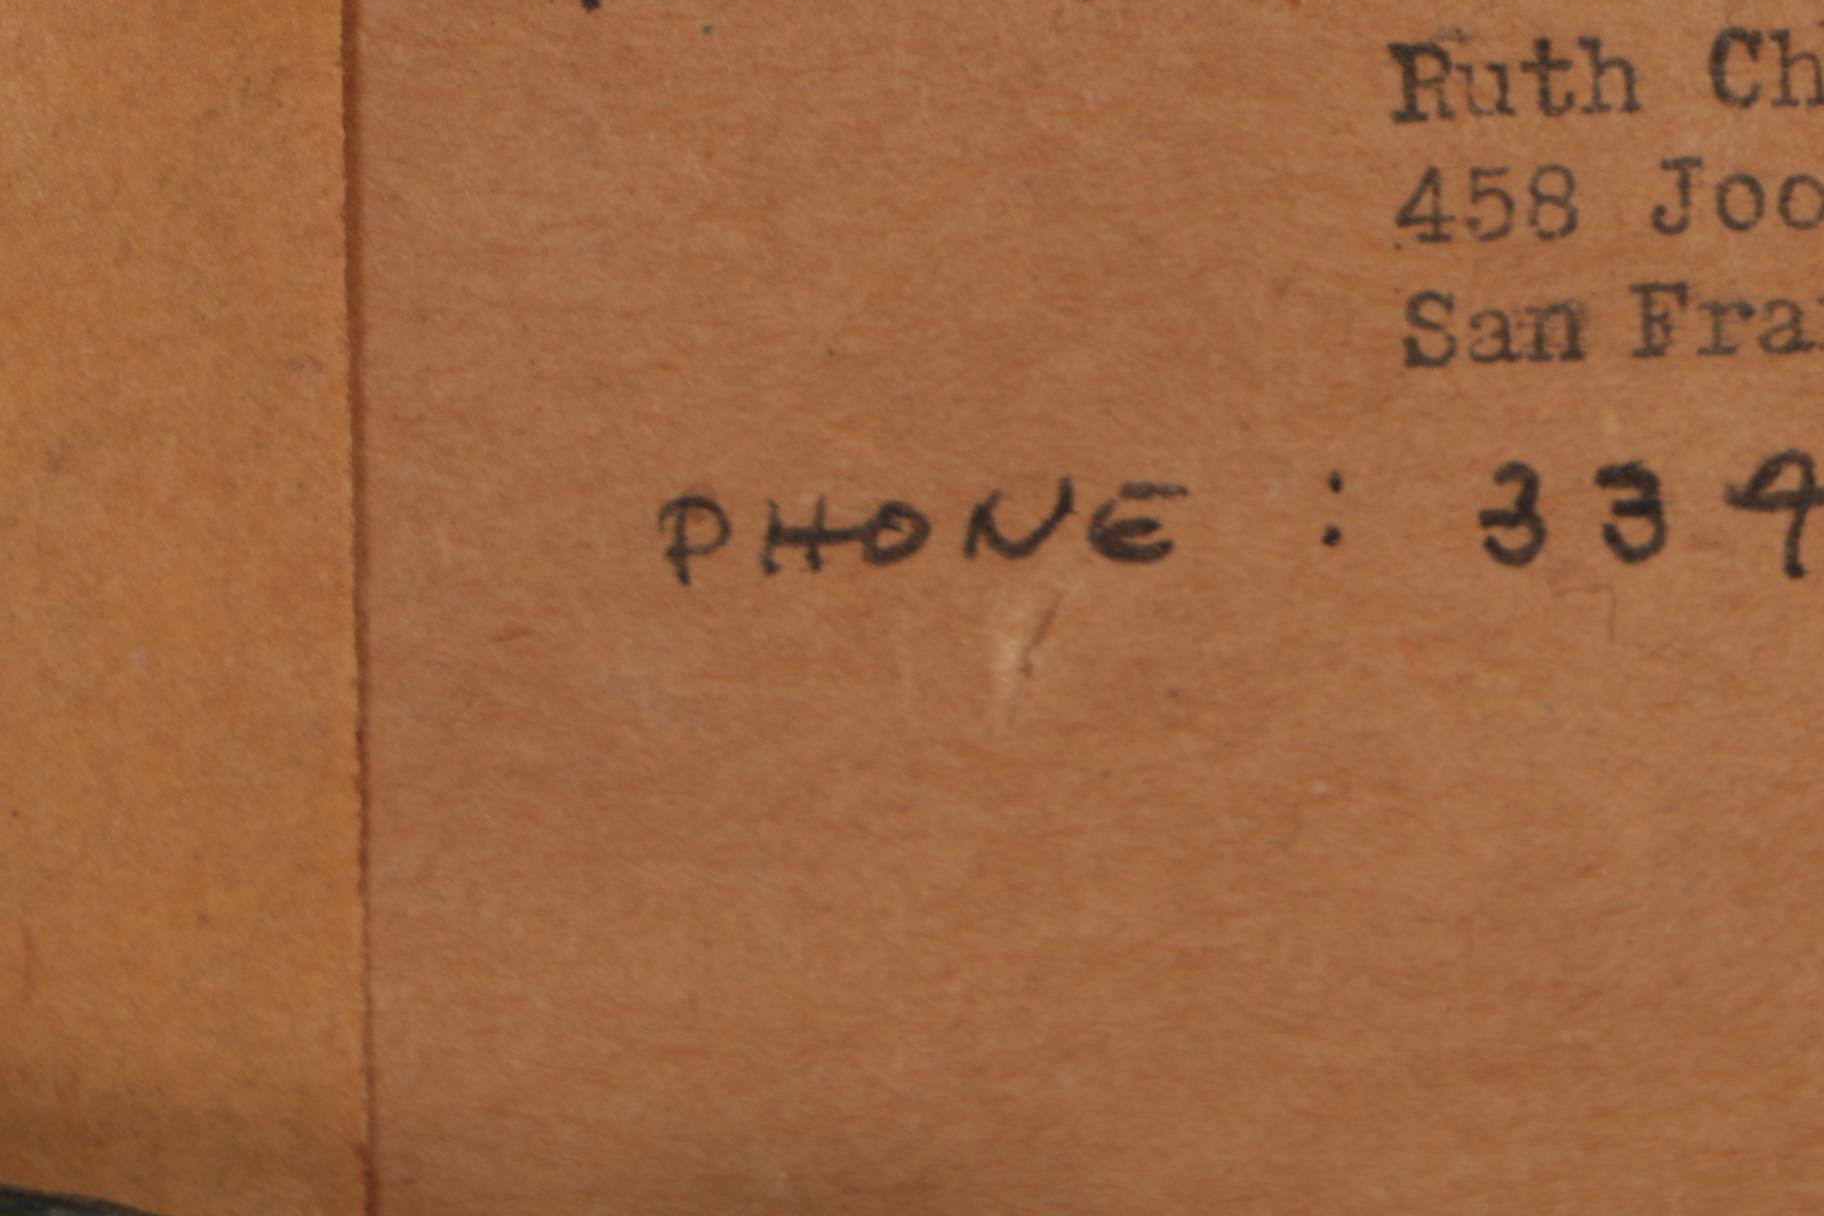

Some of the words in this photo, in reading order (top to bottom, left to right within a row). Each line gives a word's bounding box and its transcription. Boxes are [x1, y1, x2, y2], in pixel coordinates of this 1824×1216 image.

[1386, 35, 1642, 124] Ruth
[1395, 163, 1580, 244] 458
[1401, 289, 1588, 370] San
